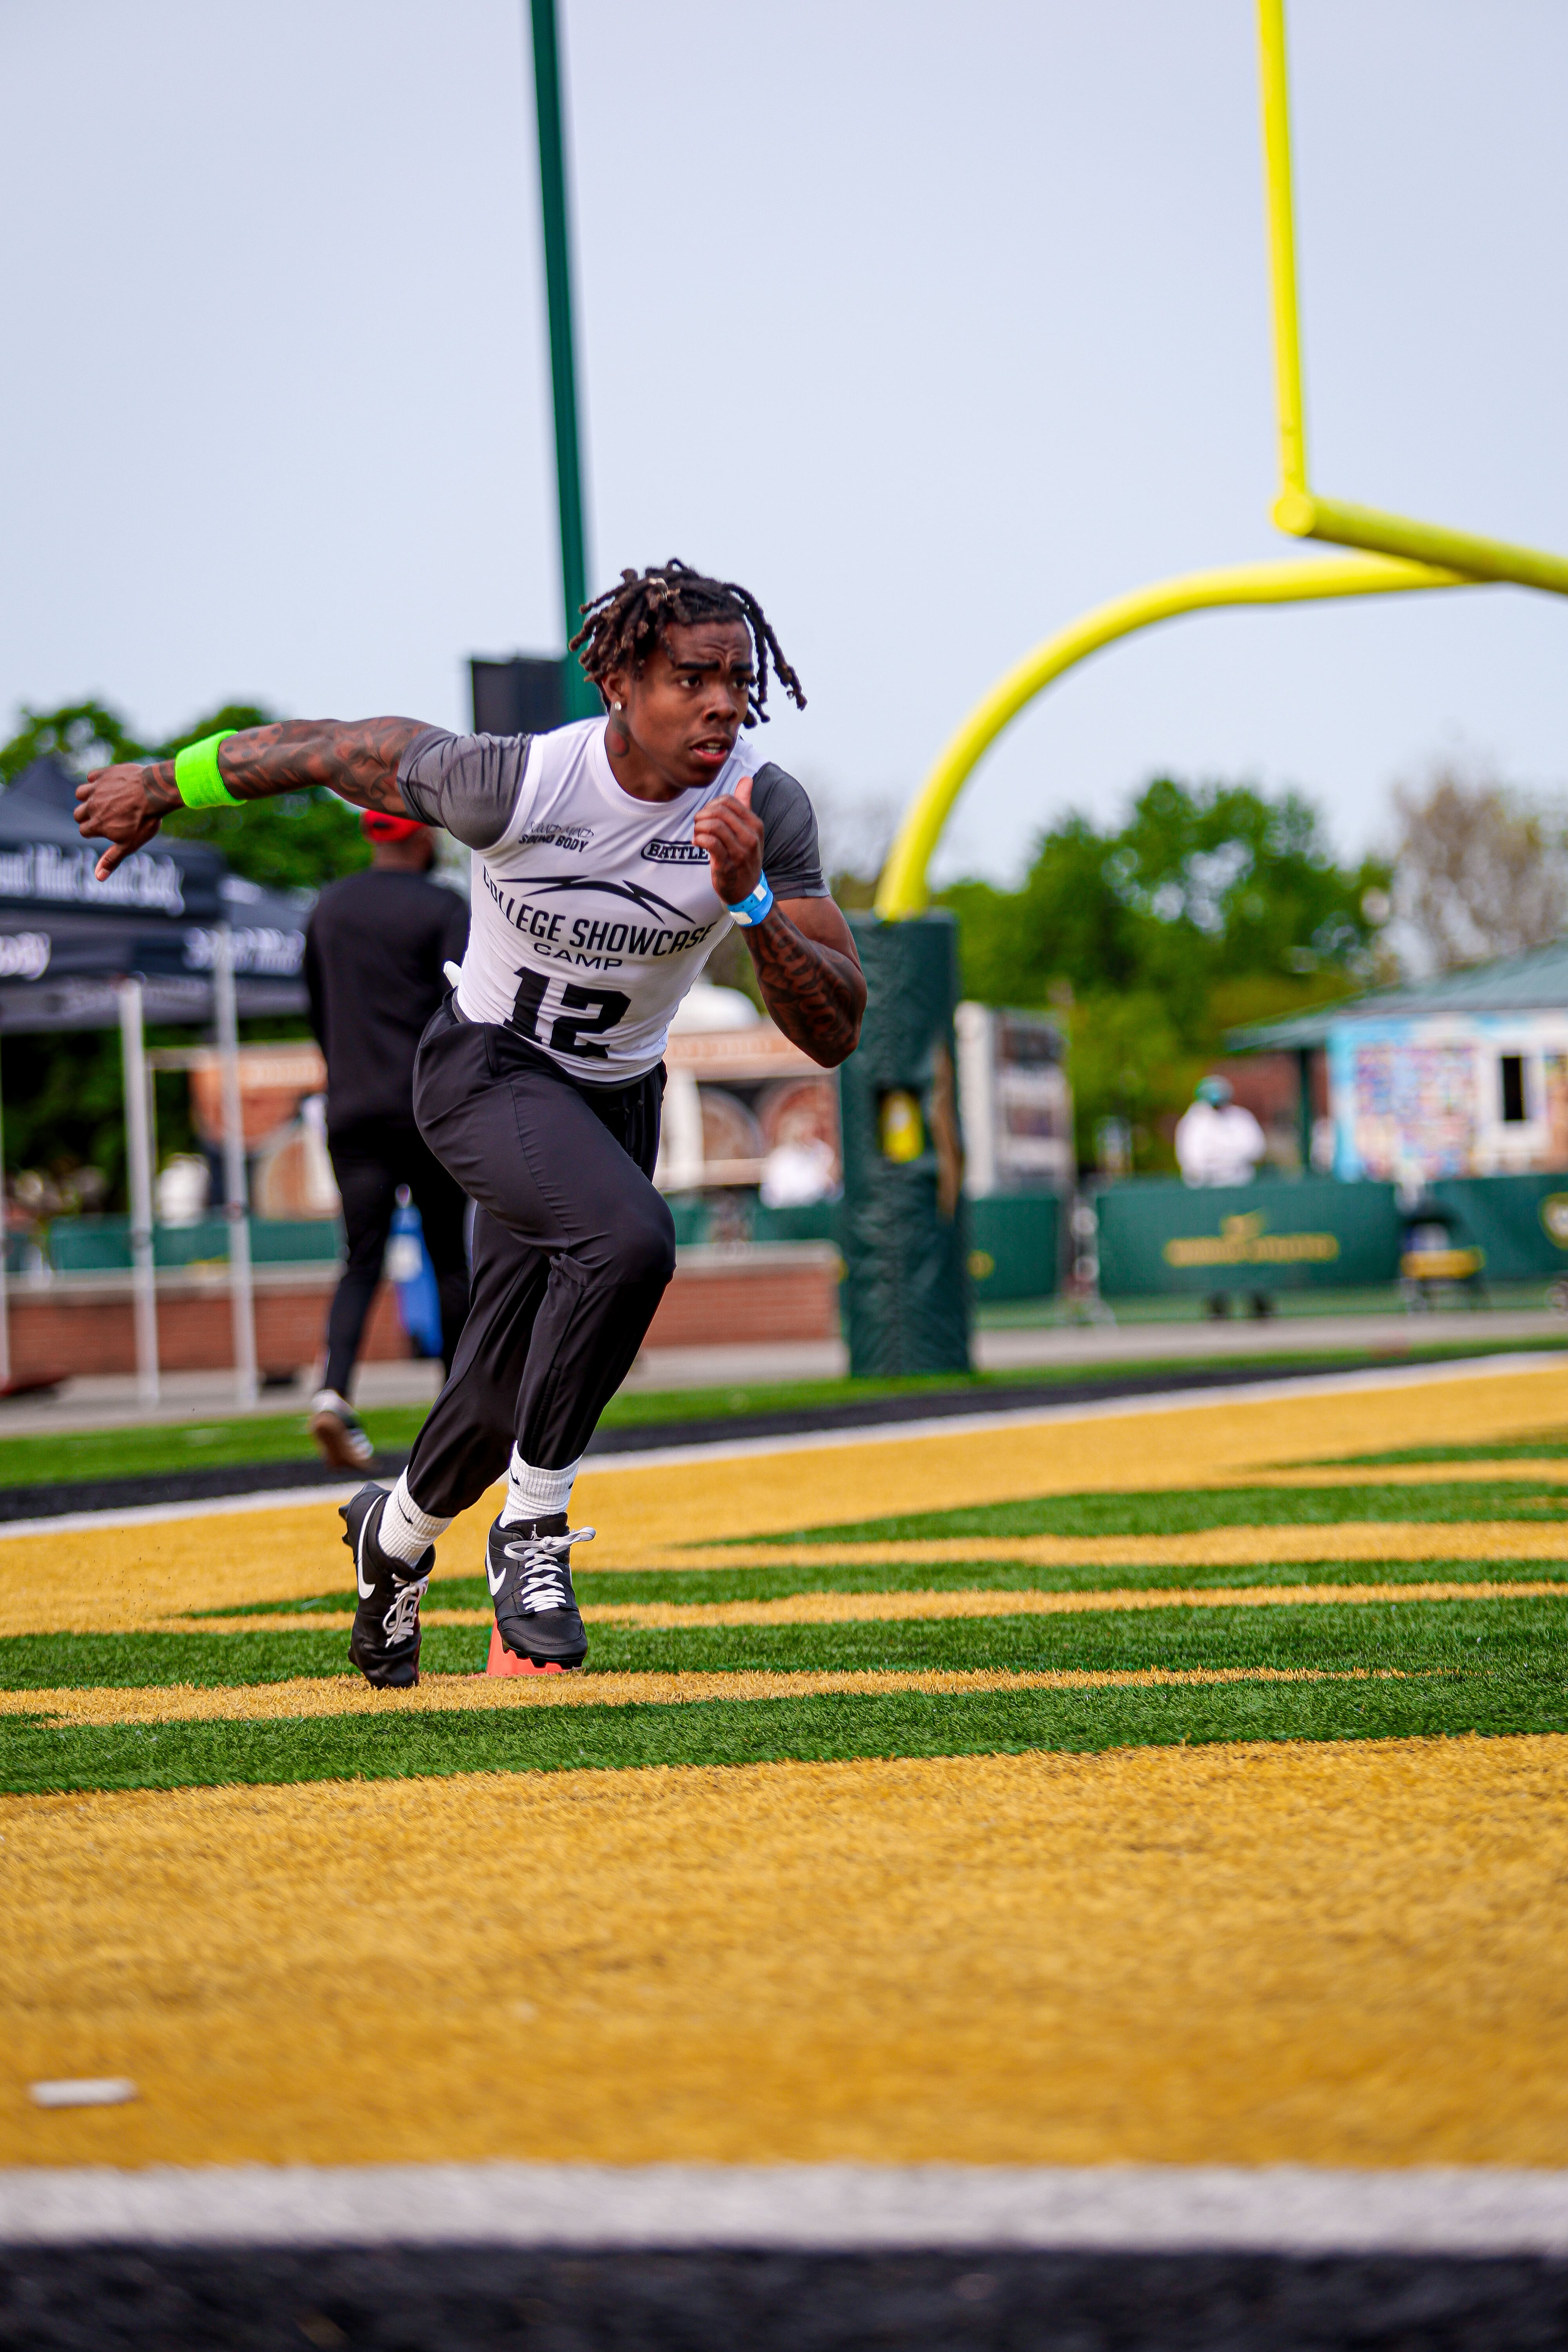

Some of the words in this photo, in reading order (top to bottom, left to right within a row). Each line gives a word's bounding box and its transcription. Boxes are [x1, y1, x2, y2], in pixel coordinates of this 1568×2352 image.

[555, 835, 589, 852] BODY
[647, 843, 708, 859] BATTLE
[483, 864, 566, 942] COLLEGE
[569, 918, 718, 956] SHOWCASE
[534, 942, 623, 971] CAMP
[503, 966, 632, 1059] 12
